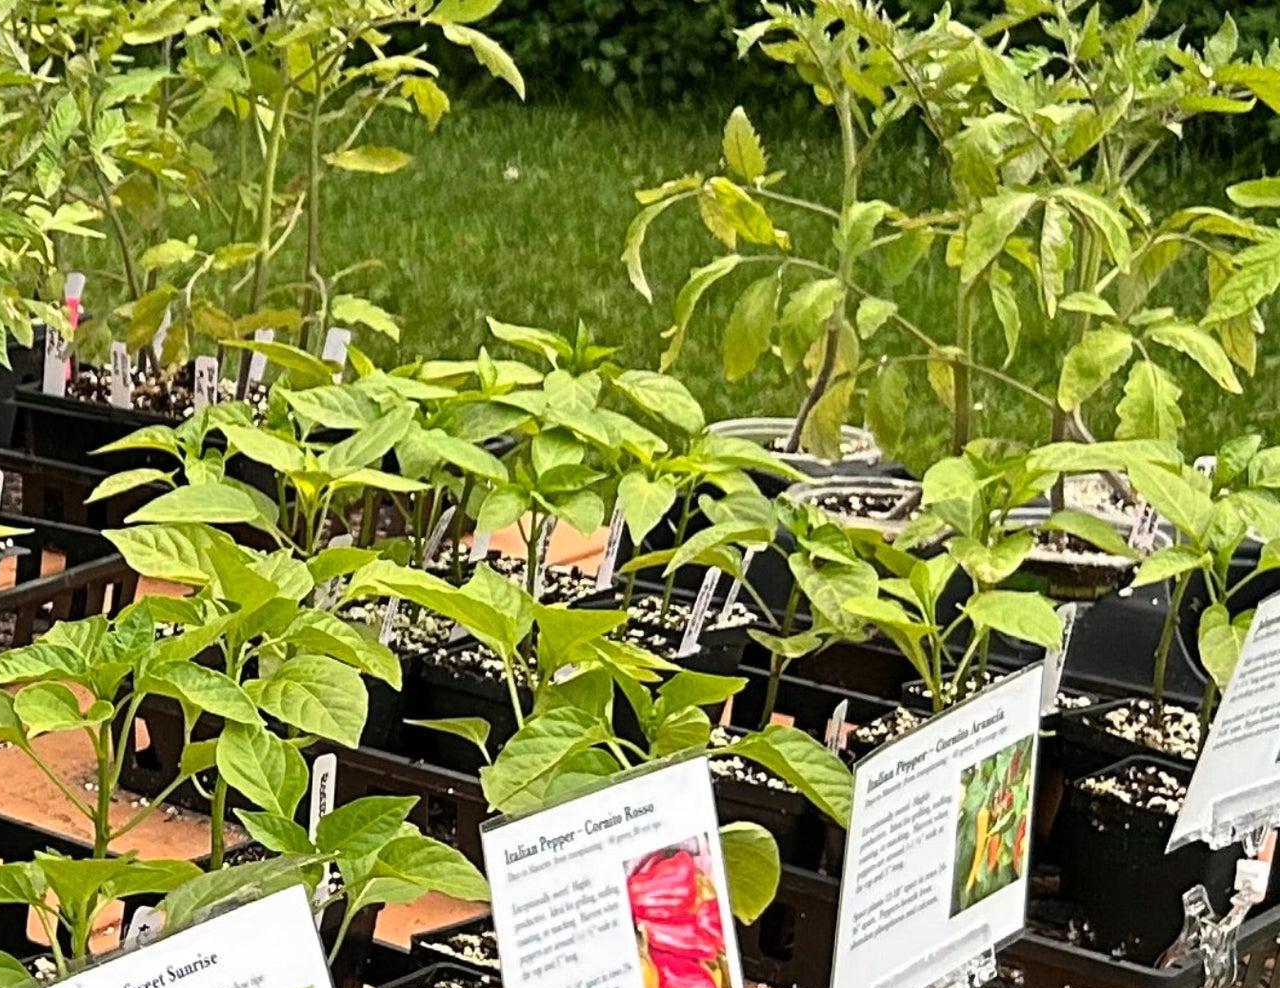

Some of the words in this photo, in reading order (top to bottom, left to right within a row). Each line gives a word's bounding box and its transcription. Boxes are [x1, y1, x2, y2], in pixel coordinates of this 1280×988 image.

[503, 844, 538, 865] Italian
[538, 830, 575, 852] Pepper
[583, 814, 622, 835] Cornito
[623, 803, 654, 821] Rosso
[166, 953, 217, 982] Sunrise
